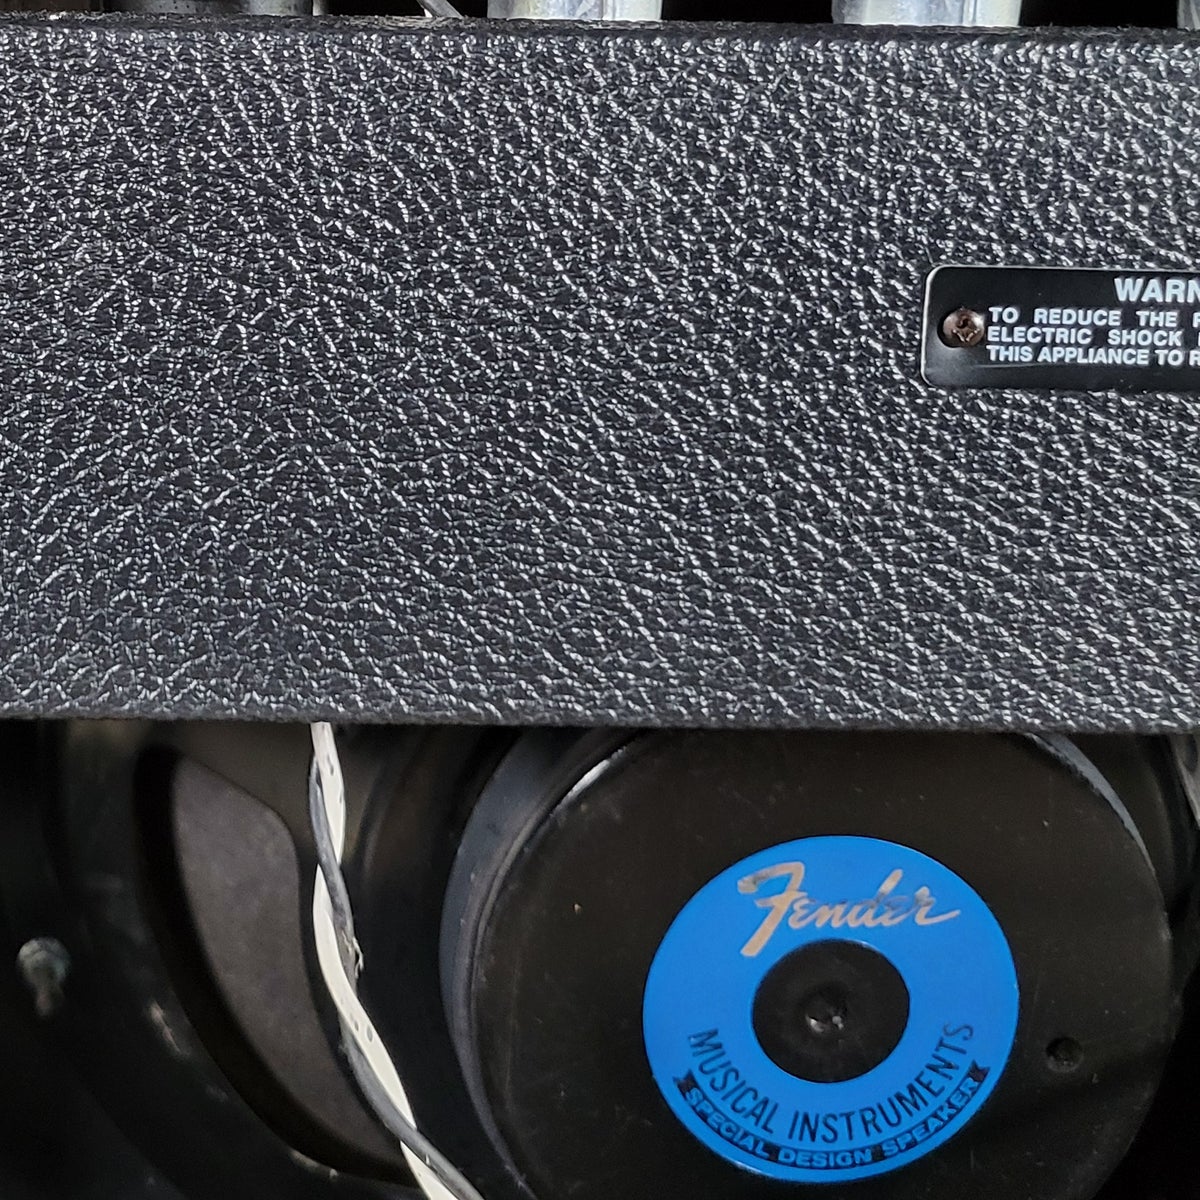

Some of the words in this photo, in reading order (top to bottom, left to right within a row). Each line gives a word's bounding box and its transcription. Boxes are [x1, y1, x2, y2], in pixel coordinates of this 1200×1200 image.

[987, 326, 1092, 344] ELECTRIC
[1108, 330, 1182, 346] SHOCK
[989, 307, 1019, 324] TO
[1034, 308, 1121, 326] REDUCE
[1136, 311, 1178, 327] THE
[987, 345, 1033, 362] THIS
[1038, 348, 1149, 365] APPLIANCE
[1155, 349, 1184, 366] TO
[737, 861, 961, 958] Fender
[687, 1028, 777, 1133] MUSICAL
[789, 1021, 975, 1144] INSTRUMENTS
[684, 1088, 769, 1160] SPECIAL
[778, 1147, 873, 1168] DESIGN
[881, 1077, 980, 1159] SPEAKER
